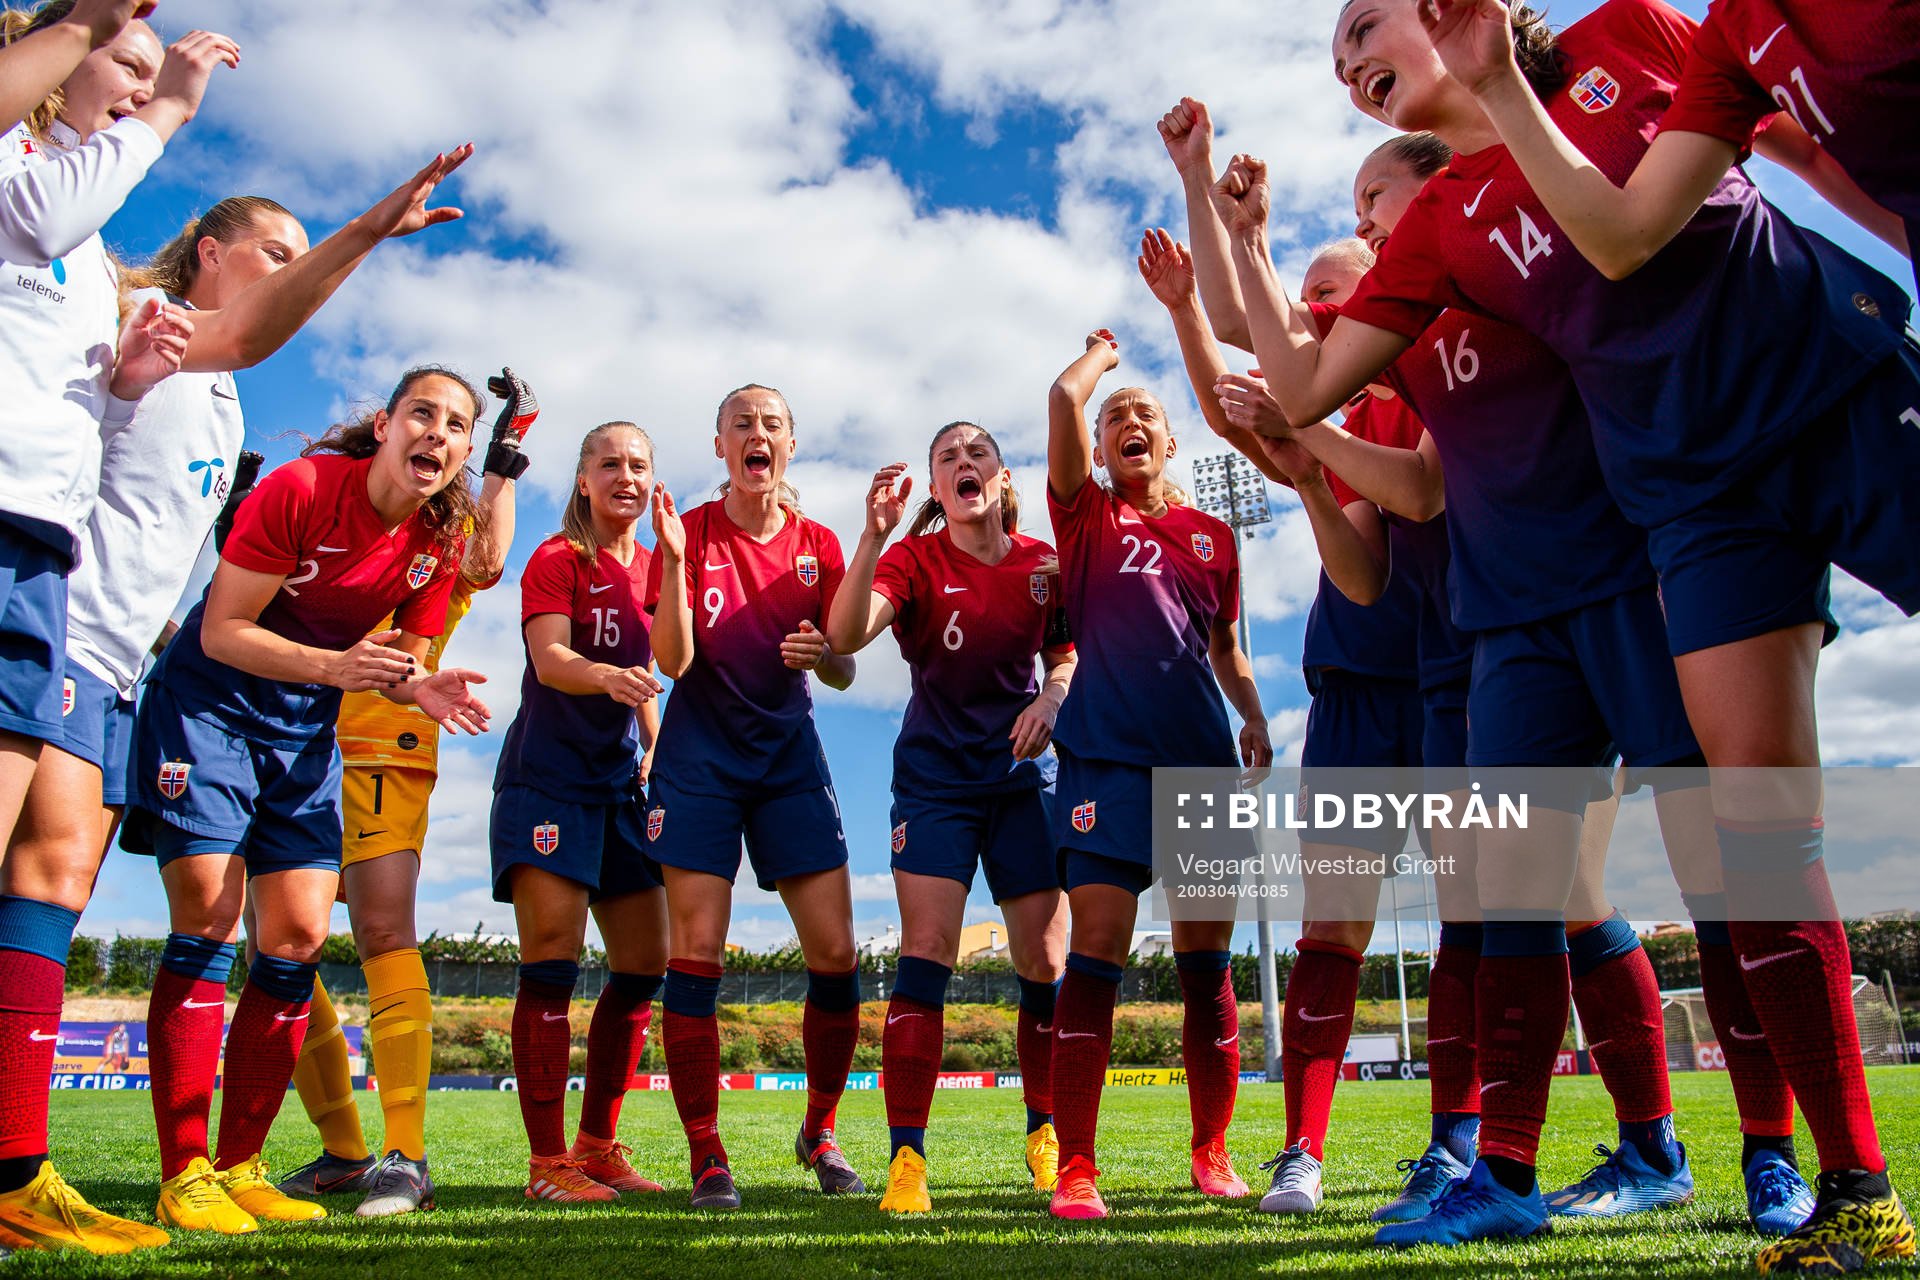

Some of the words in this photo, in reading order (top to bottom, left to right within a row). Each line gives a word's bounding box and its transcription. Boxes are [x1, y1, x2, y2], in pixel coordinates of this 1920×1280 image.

[1488, 204, 1554, 280] 14
[17, 274, 67, 304] telenor
[1434, 328, 1480, 391] 16
[1118, 534, 1164, 576] 22
[591, 607, 621, 648] 15
[703, 586, 725, 628] 9
[943, 610, 964, 651] 6
[370, 773, 384, 815] 1
[1112, 1073, 1157, 1087] Hertz
